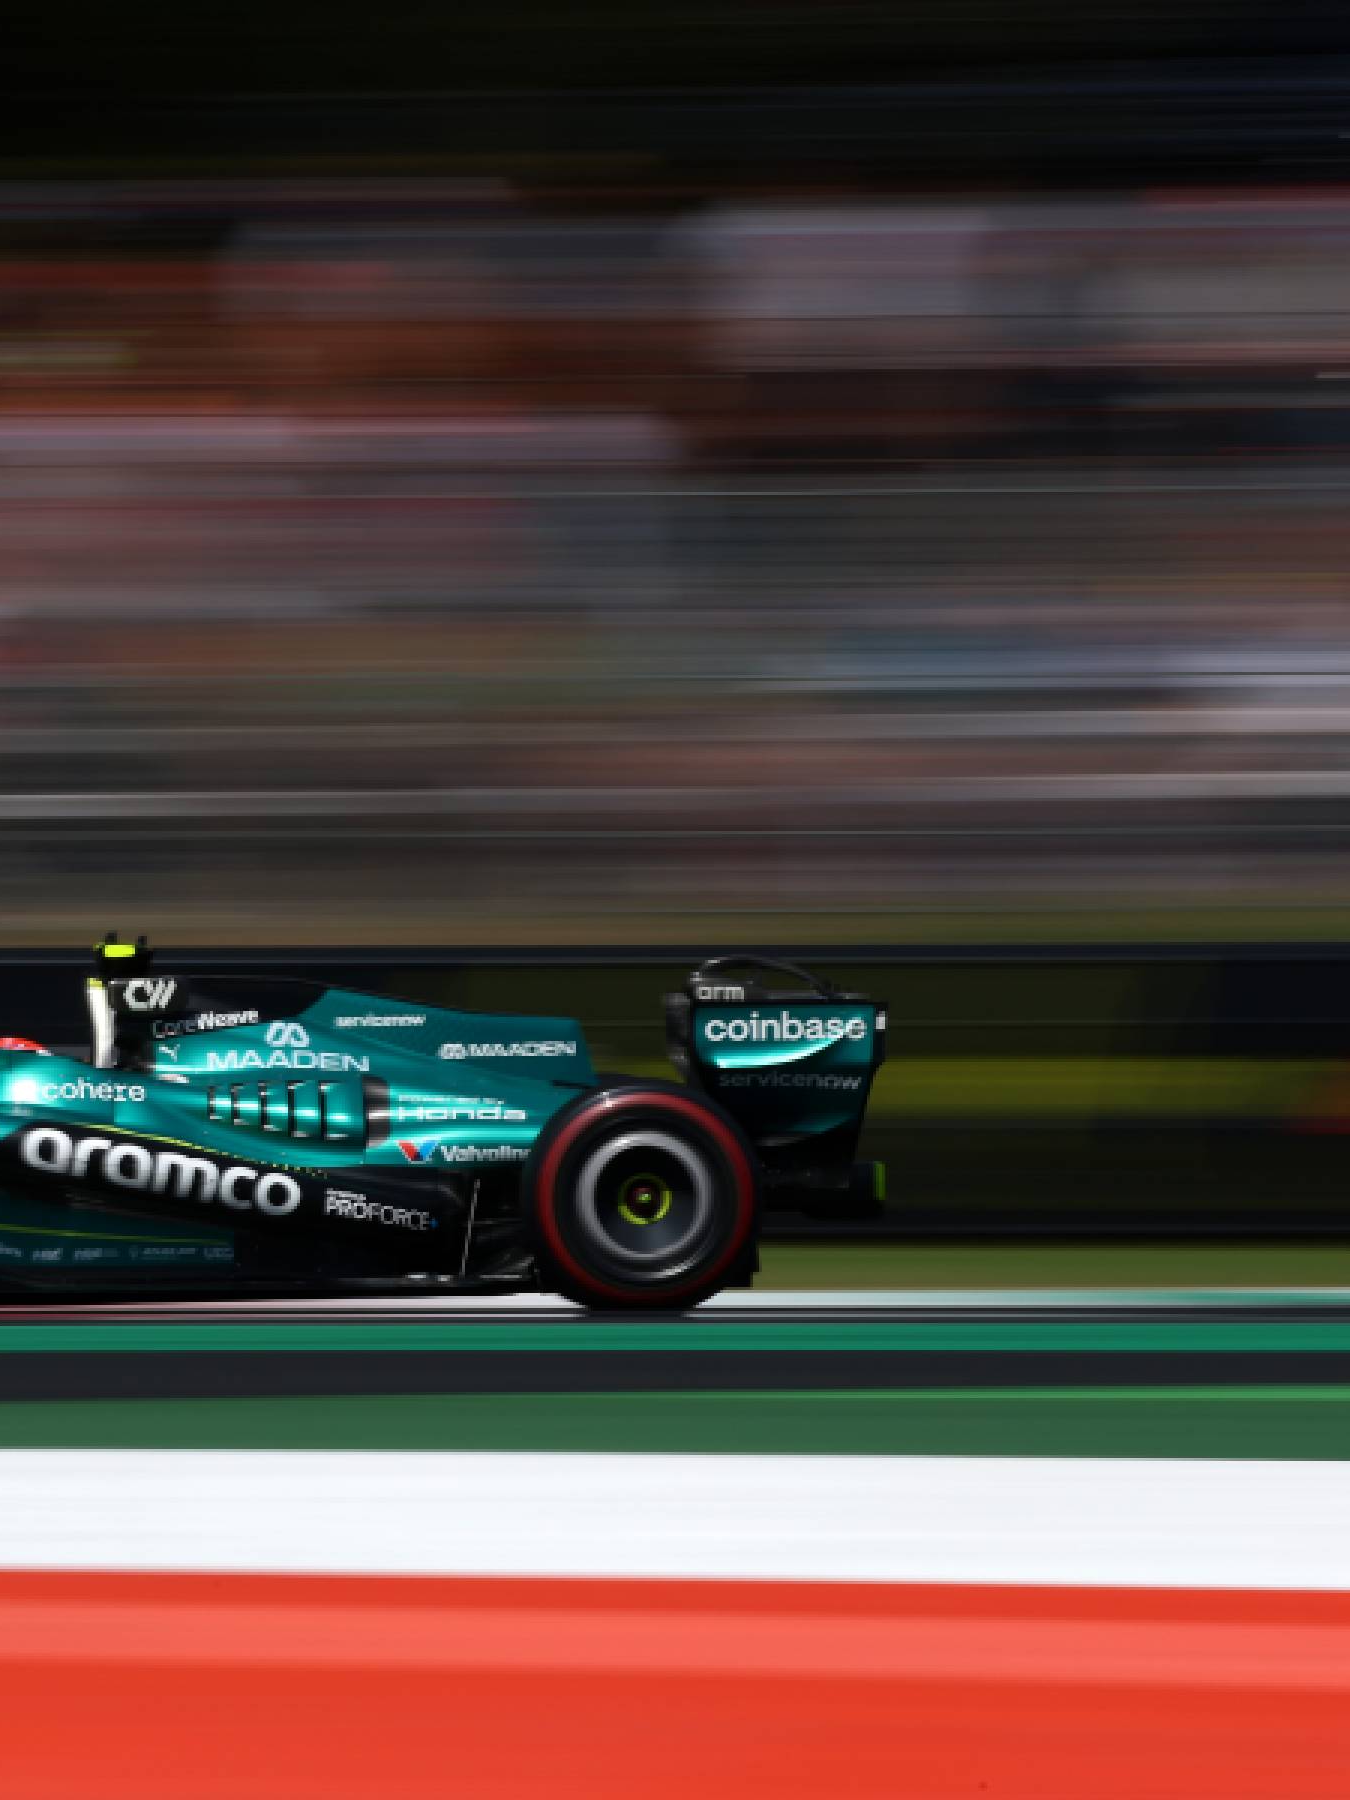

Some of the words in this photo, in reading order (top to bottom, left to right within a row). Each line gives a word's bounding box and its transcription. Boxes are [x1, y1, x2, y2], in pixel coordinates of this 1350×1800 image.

[697, 985, 745, 1001] arm
[152, 1009, 259, 1039] CoreWeave
[335, 1012, 426, 1027] servicenow
[705, 1010, 868, 1042] coinbase
[206, 1047, 370, 1072] MAADEN
[467, 1040, 577, 1057] MAADEN
[41, 1076, 145, 1102] cohere
[719, 1071, 863, 1091] servicenow
[398, 1106, 527, 1120] Honda
[21, 1127, 301, 1215] aramco
